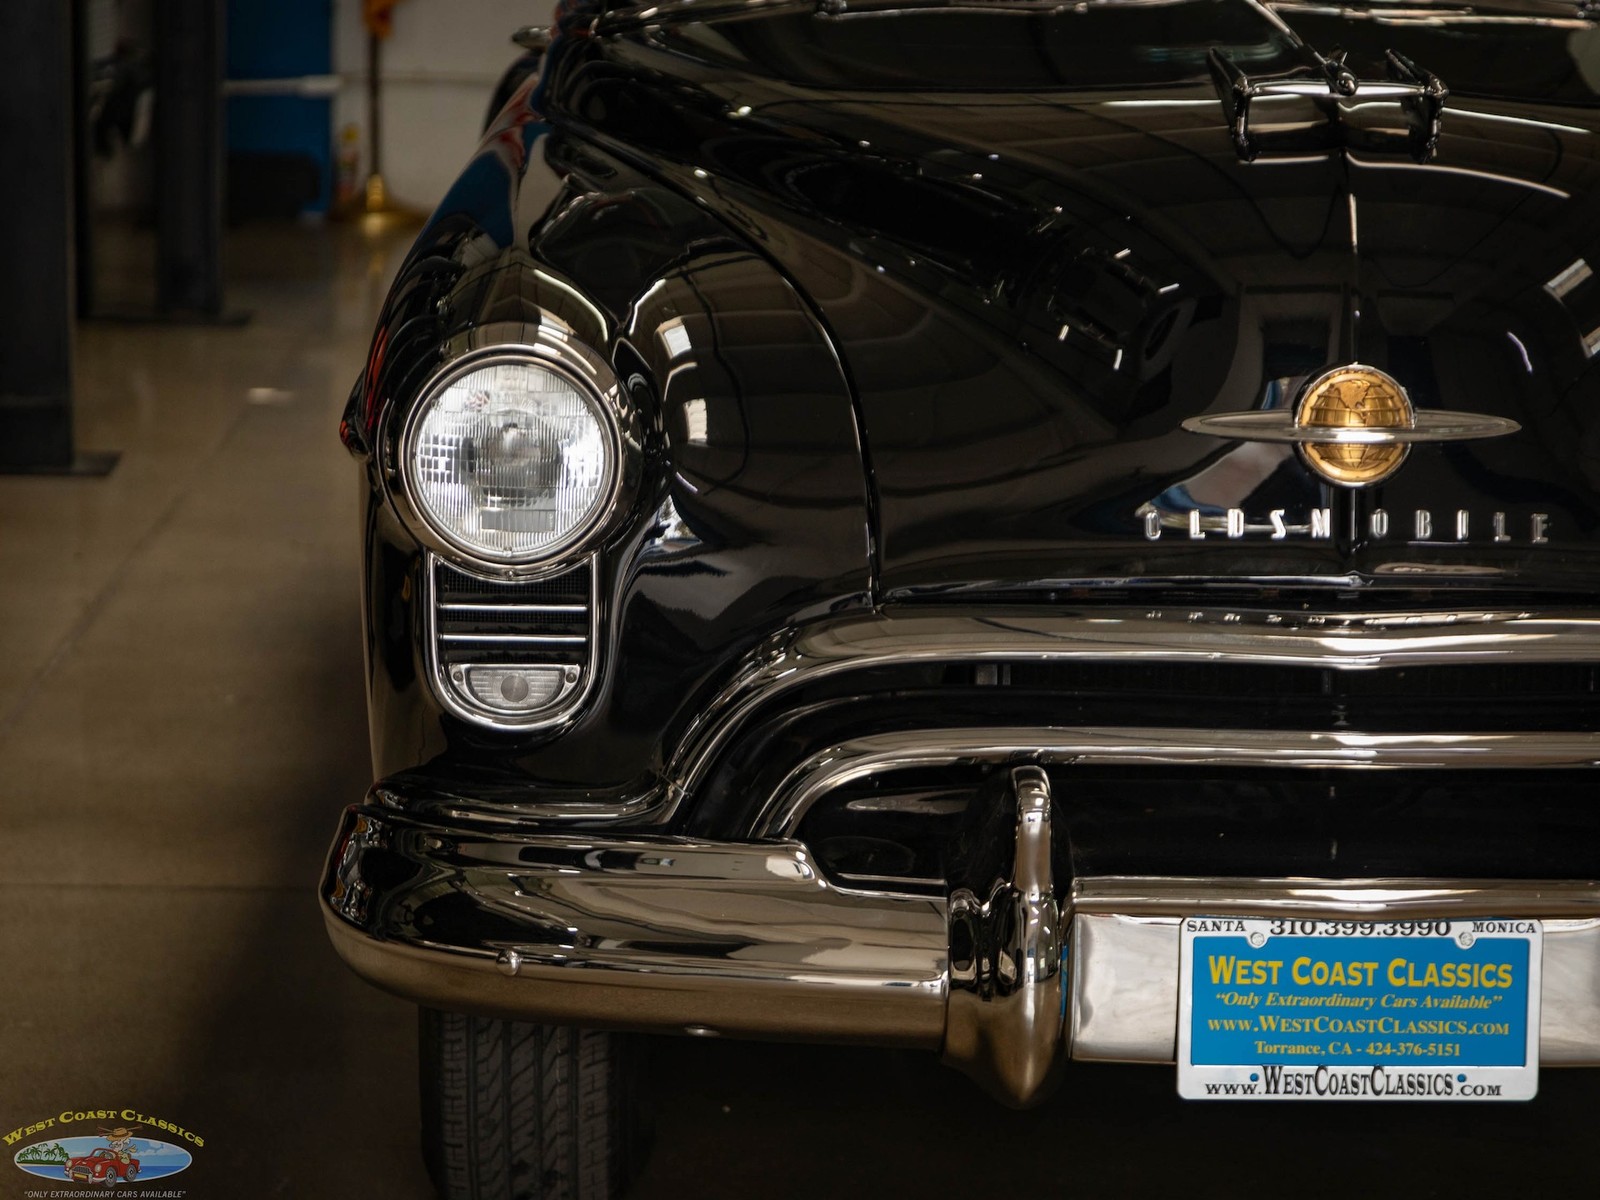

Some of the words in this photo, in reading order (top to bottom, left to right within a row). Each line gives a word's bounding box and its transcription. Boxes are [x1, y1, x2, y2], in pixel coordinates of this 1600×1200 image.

[1145, 508, 1549, 544] OLDSMOBILE
[1186, 920, 1247, 932] SANTA
[1270, 919, 1452, 936] 310.399.3990
[1472, 921, 1537, 934] MONICA
[1208, 955, 1283, 985] WEST
[1291, 956, 1379, 986] COAST
[1387, 957, 1514, 988] CLASSICS
[1265, 992, 1377, 1010] Extraordinary
[1380, 993, 1418, 1008] Cars
[1254, 1040, 1325, 1055] Torrance,
[1328, 1041, 1353, 1055] CA
[1366, 1042, 1461, 1056] 424-376-5151
